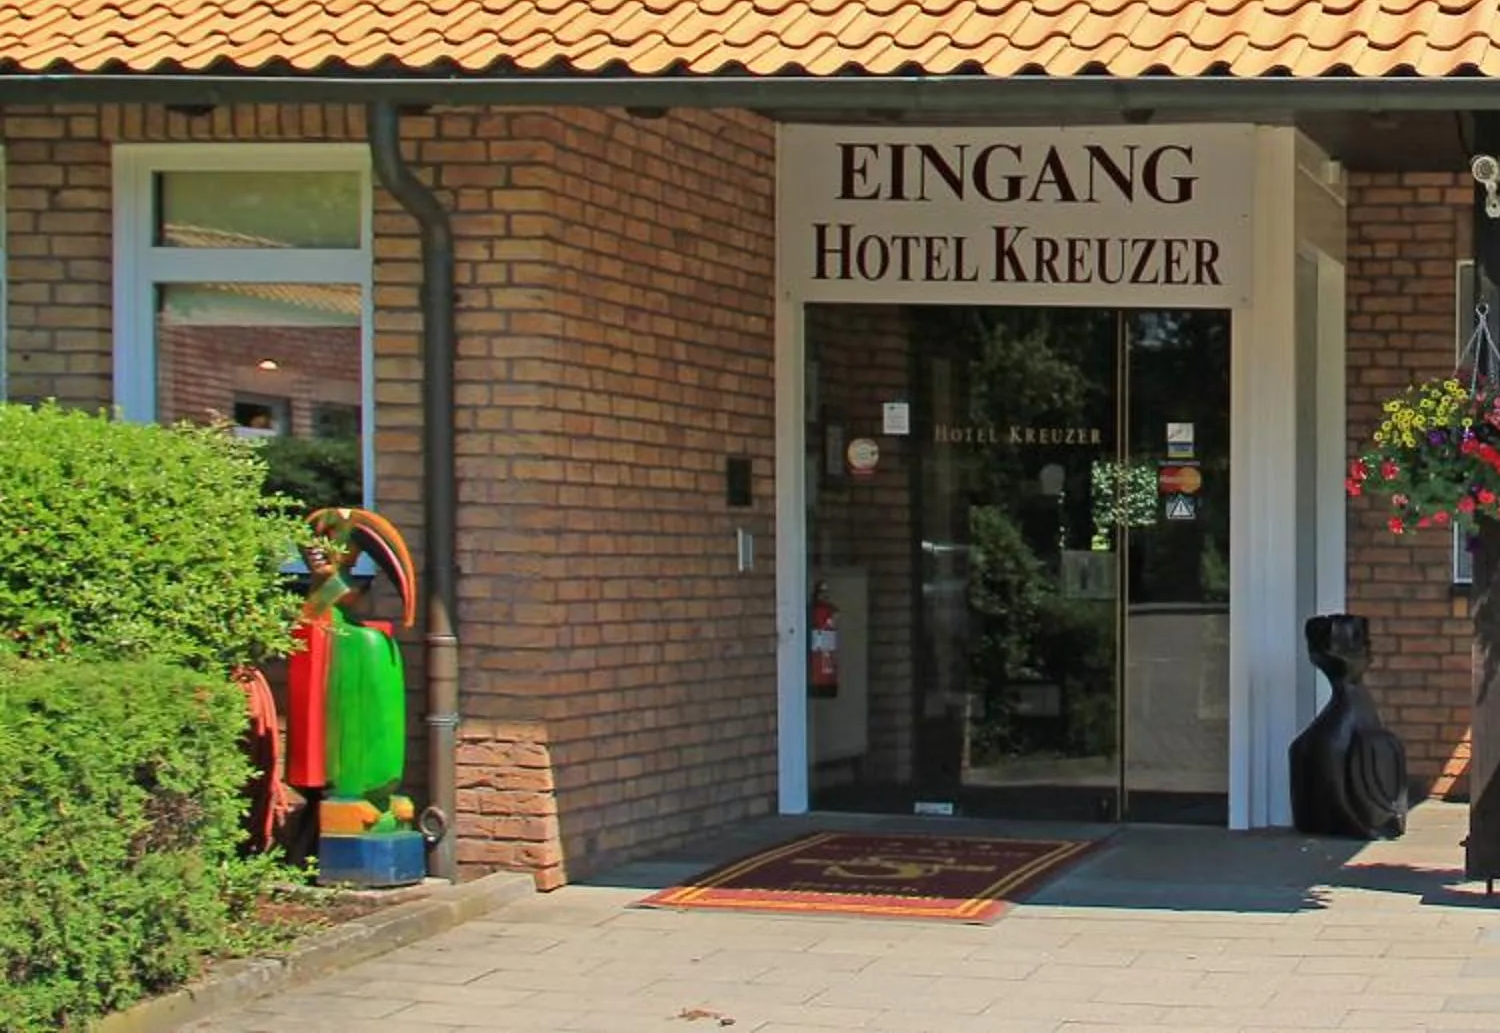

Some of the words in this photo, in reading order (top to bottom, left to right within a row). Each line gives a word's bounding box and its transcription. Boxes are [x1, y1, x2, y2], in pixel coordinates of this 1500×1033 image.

[834, 142, 1200, 204] EINGANG
[811, 222, 979, 283] HOTEL
[990, 225, 1223, 286] KREUZER
[933, 423, 999, 443] HOTEL
[1009, 425, 1102, 445] KREUZER
